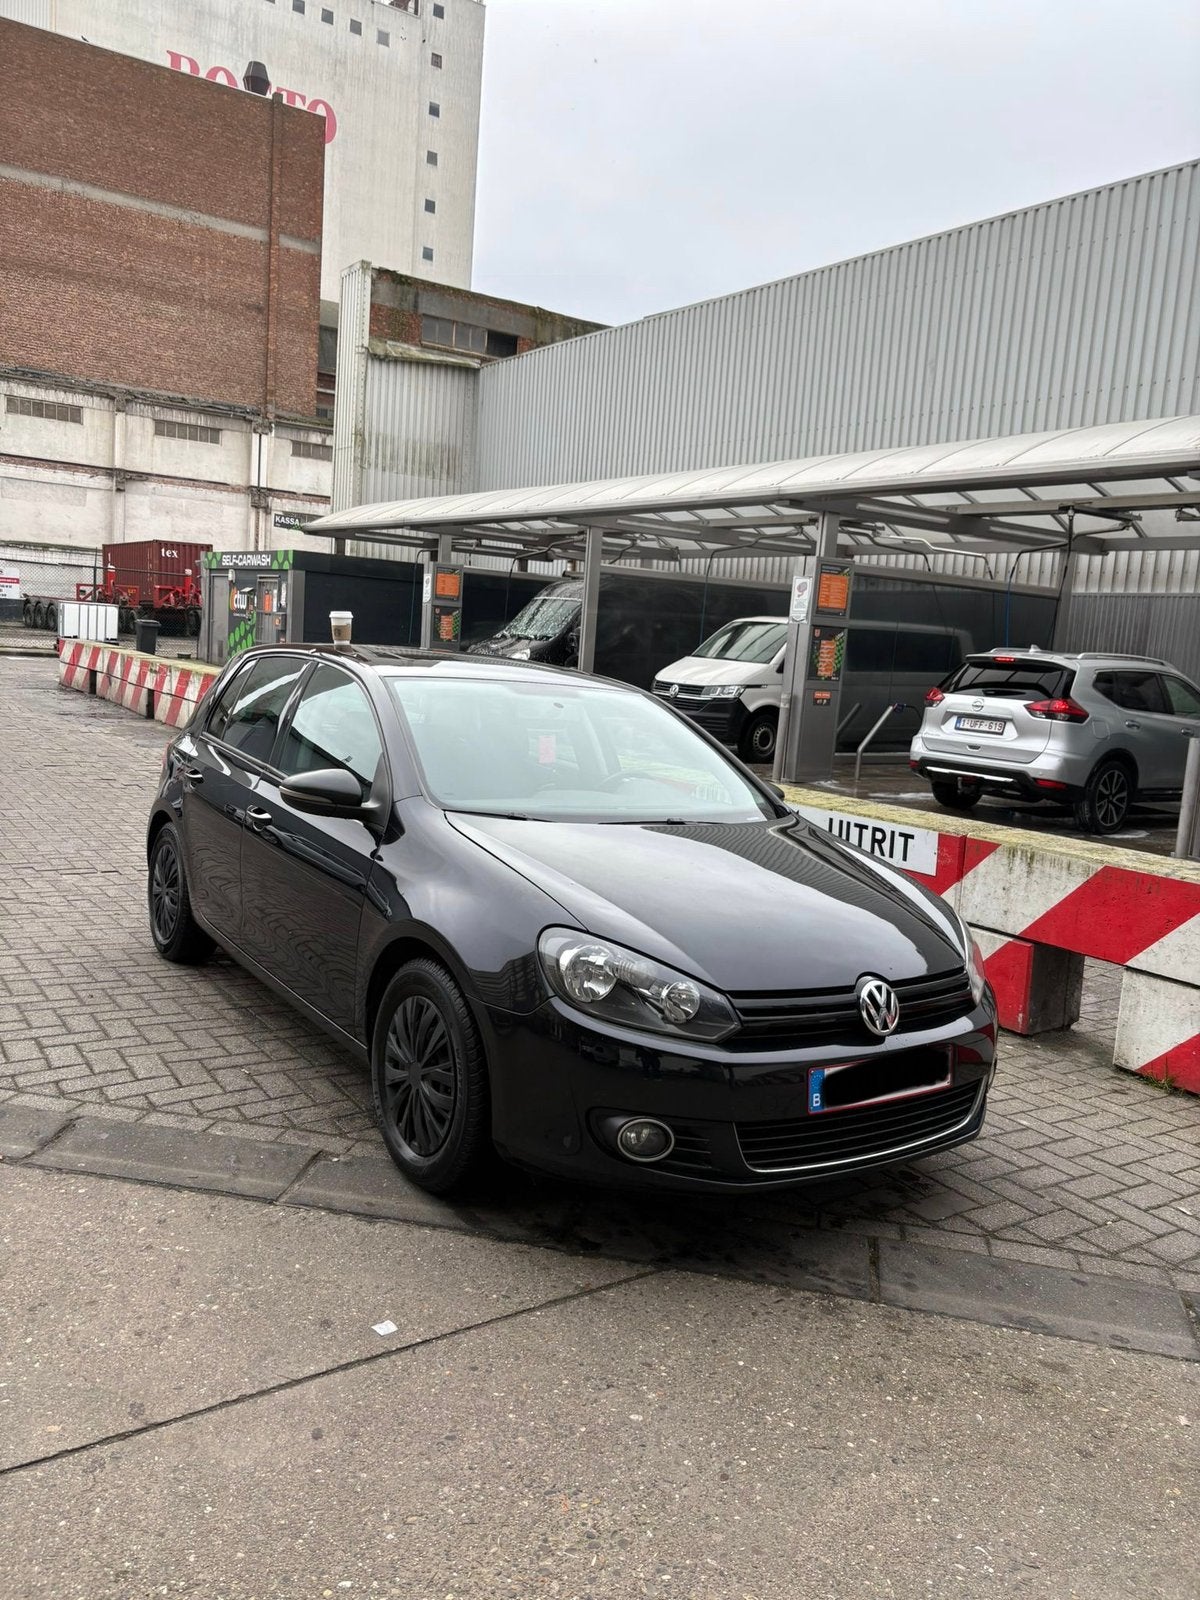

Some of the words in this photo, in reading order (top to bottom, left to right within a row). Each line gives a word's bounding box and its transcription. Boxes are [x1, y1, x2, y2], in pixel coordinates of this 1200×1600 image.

[166, 50, 337, 144] OTO
[275, 515, 300, 526] KASSA
[161, 547, 179, 559] tex
[221, 554, 272, 567] SELF-CARWASH
[962, 718, 1003, 732] 1-UFF-619
[860, 980, 900, 1036] VW
[812, 1093, 821, 1107] B
